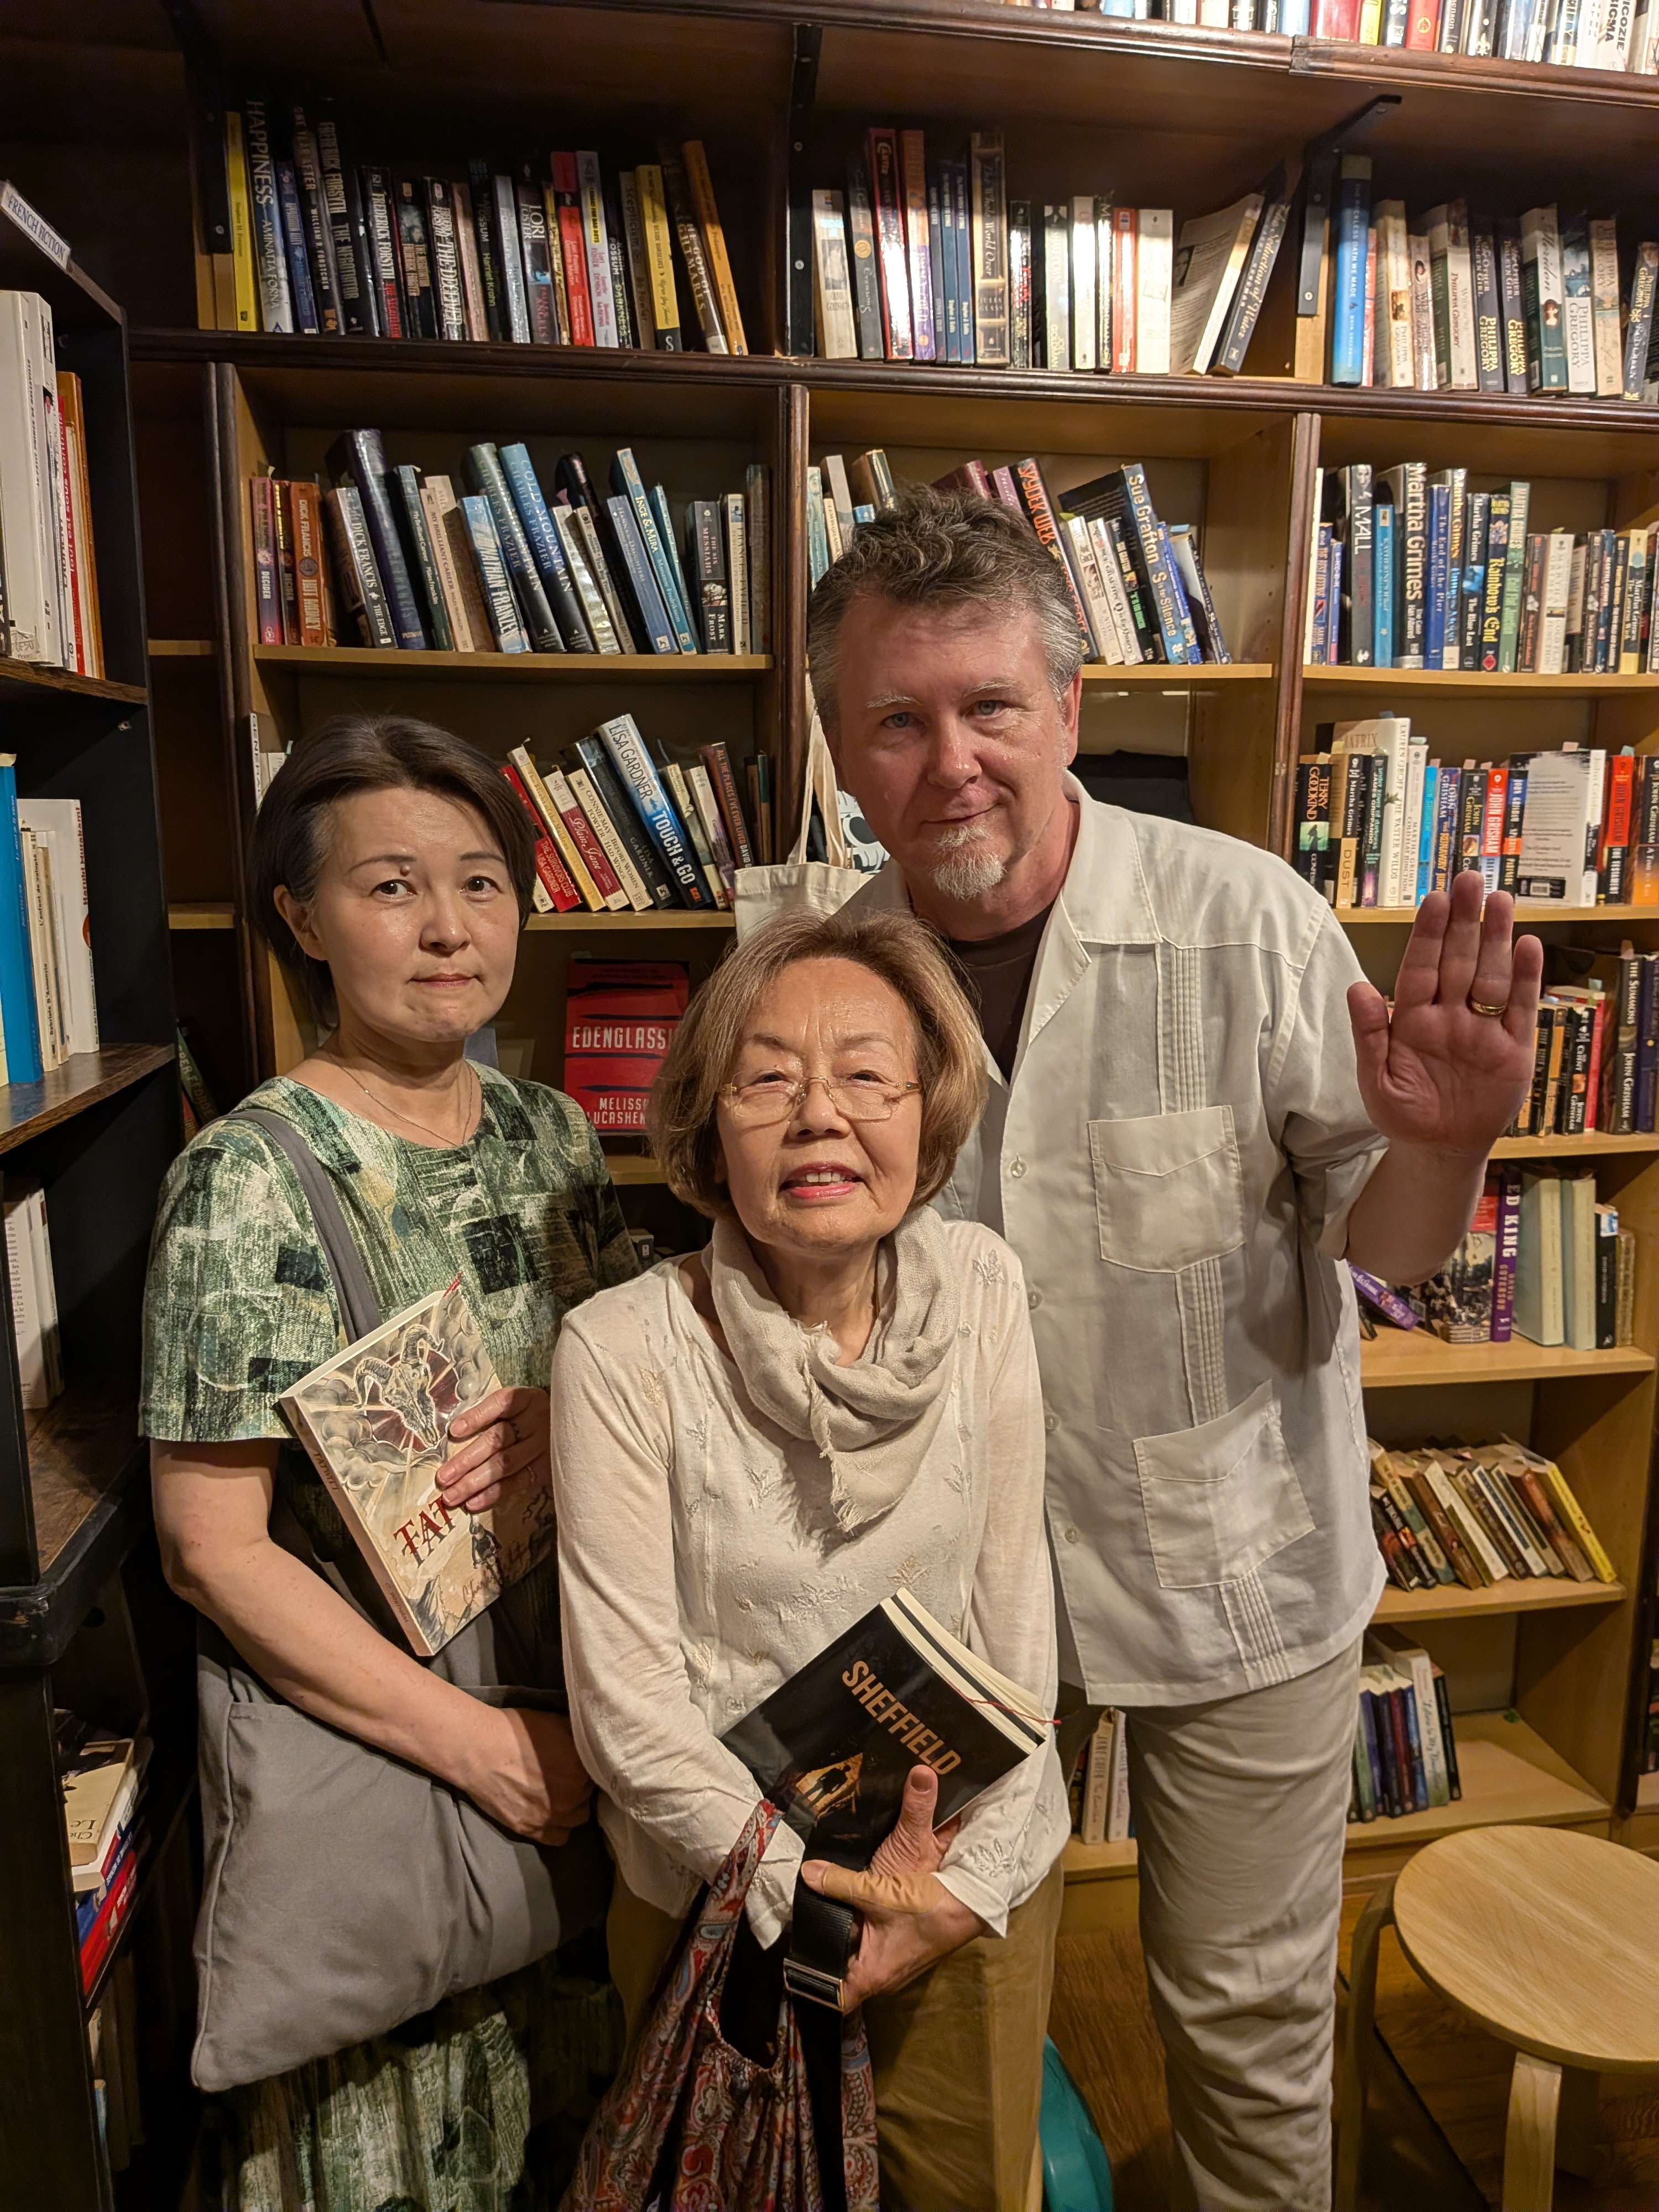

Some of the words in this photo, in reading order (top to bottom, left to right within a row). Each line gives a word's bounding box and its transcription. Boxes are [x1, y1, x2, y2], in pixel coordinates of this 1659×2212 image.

[246, 100, 273, 205] HAPPINESS
[325, 173, 347, 213] FORSYTH
[8, 194, 40, 234] FRENCH
[38, 224, 65, 261] FICTION
[373, 193, 390, 239] FREDERICK
[530, 205, 546, 238] LORI
[262, 220, 276, 271] AMINATTA
[984, 222, 995, 248] World
[1350, 241, 1359, 262] OATH
[335, 246, 359, 299] NEGOTIATOR
[377, 242, 395, 279] FORSYTH
[482, 252, 494, 281] Harriet
[984, 251, 995, 276] Over
[1254, 228, 1281, 285] Seduction
[1605, 227, 1616, 286] PHILIPPA
[267, 274, 280, 310] FORNA
[487, 282, 497, 307] Krohn
[1634, 267, 1646, 309] GREGORY
[1644, 275, 1655, 309] PHILIPPA
[1238, 302, 1261, 340] Water
[1568, 302, 1580, 369] GREGORY
[1579, 305, 1590, 367] PHILIPPA
[1050, 324, 1060, 367] GOLDMAN
[1479, 315, 1491, 372] GREGORY
[1488, 317, 1500, 372] PHILIPPA
[1507, 319, 1519, 376] GREGORY
[1517, 320, 1526, 375] PHILIPPA
[62, 478, 71, 513] sous
[1018, 462, 1045, 514] SPYDER
[1032, 514, 1056, 545] WEB
[1128, 473, 1146, 504] Sue
[1406, 466, 1426, 531] Martha
[1453, 474, 1465, 516] Martha
[1513, 487, 1528, 519] MARTHA
[298, 499, 308, 520] DICK
[508, 462, 533, 520] CHARLES
[528, 520, 552, 570] FRAZIER
[521, 459, 543, 503] COLD
[535, 508, 573, 593] MOUNTAIN
[1472, 498, 1483, 529] Martha
[300, 520, 311, 557] FRANCIS
[351, 522, 366, 546] DICK
[498, 521, 522, 569] FRAZIER
[644, 528, 659, 554] MIRA
[1136, 504, 1161, 565] Grafton
[1354, 504, 1373, 555] MALL
[1451, 518, 1463, 559] Grimes
[1470, 532, 1481, 562] Grimes
[1510, 520, 1525, 549] GRIMES
[64, 544, 75, 572] Tout
[356, 547, 378, 588] FRANCIS
[702, 527, 713, 574] MESSIAHS
[1406, 535, 1426, 601] Grimes
[261, 570, 272, 599] DECIDER
[301, 578, 317, 597] HOT
[424, 566, 433, 578] Miles
[475, 534, 506, 589] JONATHAN
[492, 591, 517, 637] FRANZEN
[1151, 571, 1169, 583] S
[1486, 557, 1506, 613] Rainbow's
[427, 579, 439, 604] Franklin
[1468, 597, 1478, 612] The
[304, 598, 321, 630] MONEY
[372, 603, 384, 618] THE
[375, 618, 389, 637] EDGE
[708, 613, 717, 641] FROST
[717, 613, 727, 640] MARK
[1160, 598, 1178, 637] Silence
[1466, 613, 1477, 631] Blue
[1482, 617, 1500, 643] End
[608, 724, 632, 749] LISA
[1397, 724, 1408, 758] LAUREN
[716, 749, 728, 761] ALL
[719, 762, 731, 774] THE
[618, 748, 654, 800] GARDNER
[722, 774, 735, 797] PLACES
[1396, 759, 1406, 791] GROFF
[1306, 765, 1321, 820] GOODKIND
[1318, 776, 1330, 810] TERRY
[1348, 780, 1358, 807] Martha
[1439, 775, 1449, 818] GRISHAM
[1447, 784, 1457, 810] JOHN
[1488, 792, 1505, 815] JOHN
[1614, 782, 1627, 805] JOHN
[586, 789, 604, 818] CONNIE
[597, 818, 611, 836] MAY
[587, 808, 606, 837] FOWLER
[728, 809, 742, 826] EVER
[1368, 800, 1376, 844] GRIPPANDO
[1464, 796, 1476, 833] GRISHAM
[1472, 804, 1483, 826] JOHN
[1612, 806, 1625, 843] GRISHAM
[75, 806, 84, 865] Murakami
[570, 817, 594, 847] Plain
[582, 846, 603, 871] Jane
[651, 810, 683, 858] TOUCH
[732, 827, 747, 844] LIVED
[1392, 817, 1402, 849] VASTER
[1409, 821, 1418, 855] MARTHA
[1485, 816, 1503, 854] GRISHAM
[604, 841, 616, 857] HAD
[610, 857, 627, 880] WINGS
[608, 839, 623, 858] BEFORE
[617, 859, 639, 890] WOMEN
[629, 837, 653, 879] GARDNER
[672, 857, 684, 866] &
[735, 844, 752, 863] DAVID
[1341, 849, 1353, 888] DUST
[1389, 852, 1400, 880] WILDS
[1437, 833, 1449, 871] RUNAWAY
[541, 866, 559, 893] GARDNER
[674, 865, 696, 885] GO
[1401, 855, 1410, 892] JUNCTION
[1407, 858, 1416, 888] GRIMES
[1435, 873, 1447, 891] JURY
[1626, 979, 1640, 1025] SUMMONS
[572, 1026, 672, 1050] EDENGLASSI
[1623, 1052, 1636, 1077] JOHN
[587, 1112, 646, 1124] UCASHEN
[1505, 1185, 1519, 1205] ED
[1502, 1214, 1519, 1258] KING
[313, 1451, 340, 1491] TATWITT
[393, 1494, 456, 1569] TAT
[842, 1661, 961, 1775] SHEFFIELD
